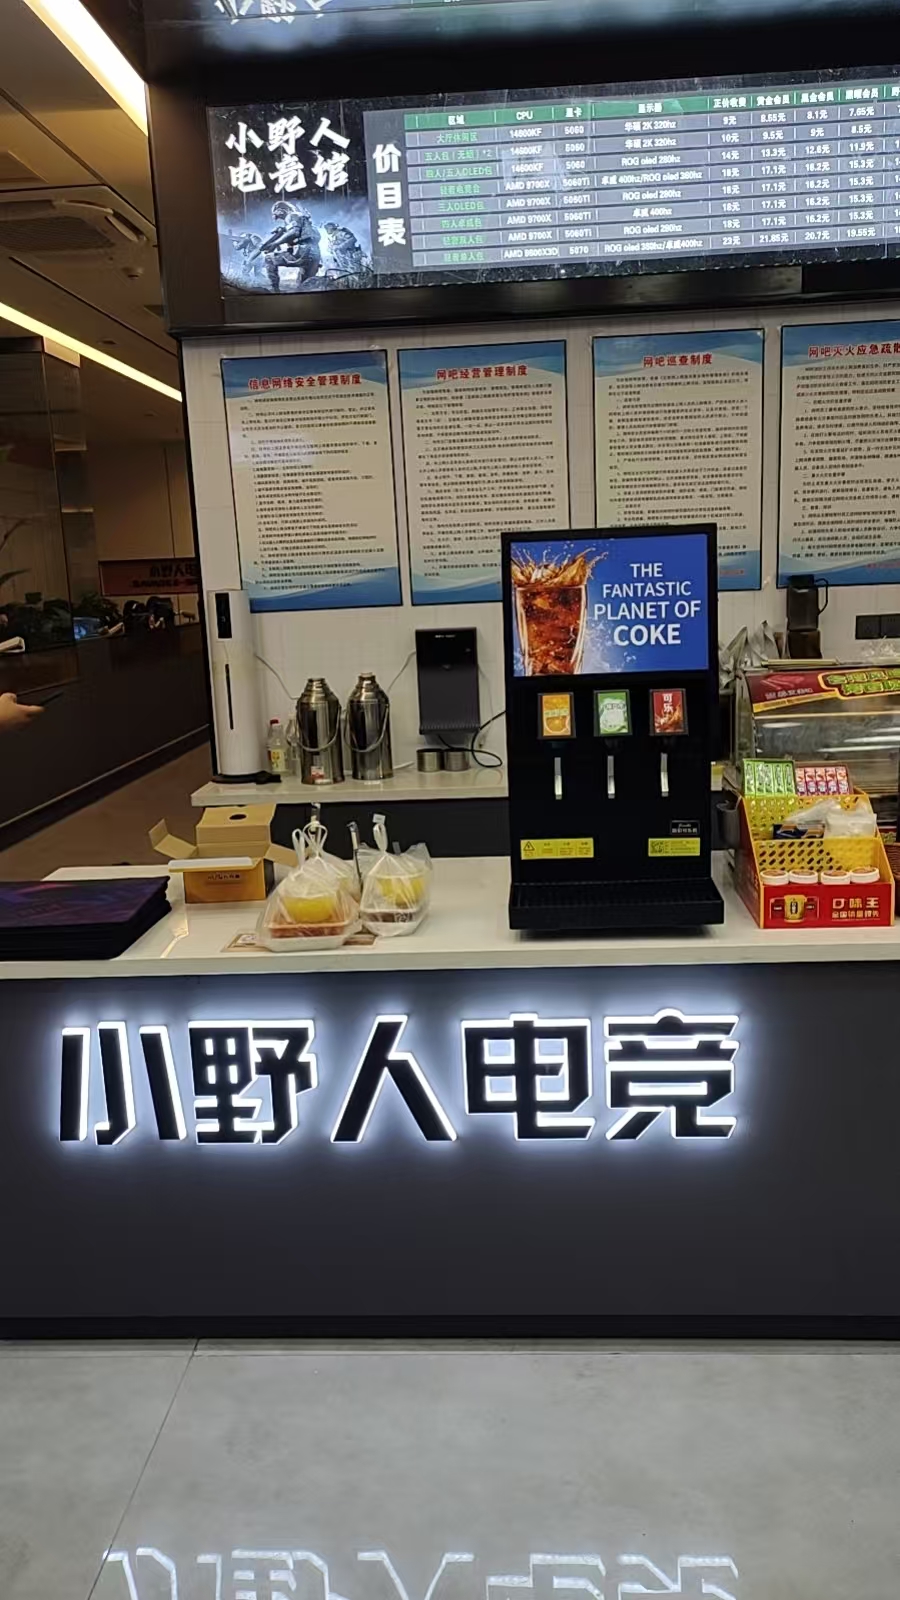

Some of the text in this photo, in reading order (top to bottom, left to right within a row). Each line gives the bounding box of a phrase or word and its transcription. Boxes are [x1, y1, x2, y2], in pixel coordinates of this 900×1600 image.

[516, 110, 534, 121] CPU
[806, 110, 828, 120] 8.1元
[723, 116, 737, 126] 9元
[810, 127, 825, 137] 9元
[851, 124, 872, 134] 8.5元
[225, 115, 351, 155] 小野人
[721, 133, 739, 143] 10元
[762, 130, 784, 140] 9.5元
[805, 144, 830, 155] 12.6元
[849, 141, 875, 152] 11.9元
[721, 150, 740, 160] 14元
[761, 147, 786, 157] 13.3元
[621, 157, 639, 166] ROG
[849, 159, 874, 169] 15.3元
[761, 165, 786, 174] 17.1元
[805, 162, 830, 172] 16.2元
[228, 152, 351, 193] 电竞馆
[805, 179, 830, 189] 16.2元
[849, 176, 874, 186] 15.3元
[505, 182, 525, 191] AMD
[761, 182, 786, 192] 17.1元
[372, 143, 406, 247] 价目表
[622, 192, 641, 201] ROG
[849, 193, 874, 203] 15.3元
[506, 199, 525, 208] AMD
[761, 199, 786, 209] 17.1元
[805, 196, 830, 206] 16.2元
[722, 202, 740, 212] 18元
[805, 213, 830, 224] 16.2元
[849, 210, 874, 220] 15.3元
[507, 216, 526, 225] AMD
[722, 219, 740, 229] 18元
[761, 216, 786, 226] 17.1元
[623, 226, 641, 235] ROG
[804, 230, 831, 240] 20.7元
[847, 227, 876, 238] 19.55元
[508, 232, 527, 241] AMD
[722, 236, 741, 246] 23元
[759, 233, 789, 243] 21.85元
[569, 246, 589, 255] 5070
[604, 244, 622, 253] ROG
[504, 250, 523, 258] AMD
[643, 353, 713, 367] 网吧巡查制度
[436, 365, 528, 380] 网吧经营管理制度
[249, 373, 362, 390] 信息网络安全管理制度
[630, 563, 663, 578] THE
[603, 581, 691, 598] FANTASTIC
[594, 600, 701, 620] PLANET OF
[613, 624, 681, 646] COKE
[662, 693, 673, 713] 可乐
[832, 897, 879, 909] 口味王
[58, 1006, 740, 1146] 小野人电竞
